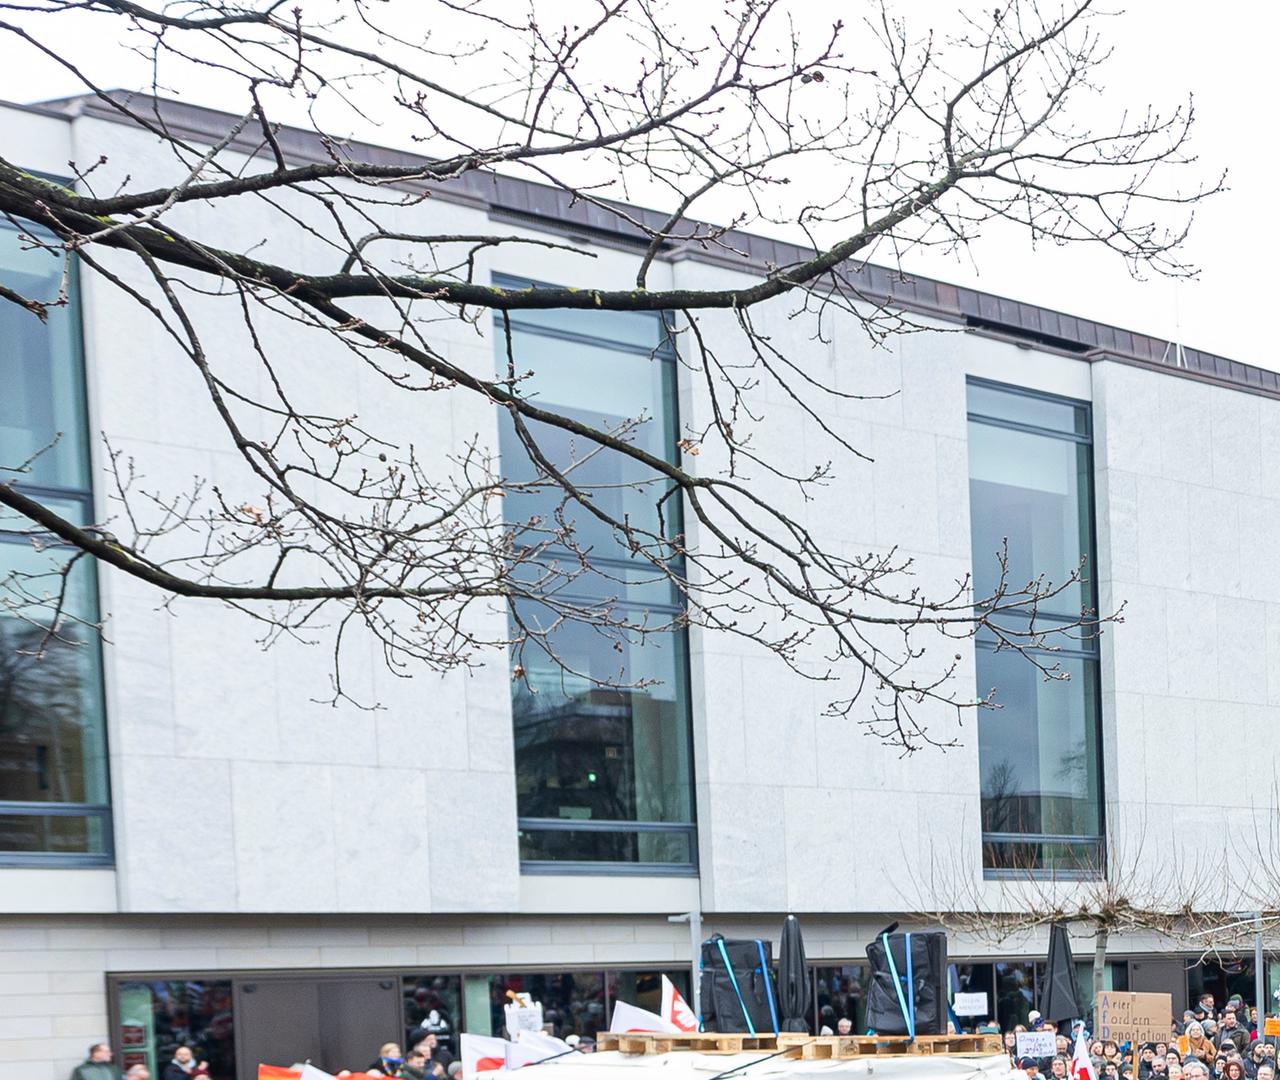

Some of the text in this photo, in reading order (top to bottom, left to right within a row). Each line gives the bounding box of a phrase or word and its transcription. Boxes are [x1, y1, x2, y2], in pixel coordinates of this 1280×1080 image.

[1102, 994, 1130, 1009] Arier
[1102, 1010, 1150, 1025] fordern
[1102, 1026, 1167, 1042] Deportation
